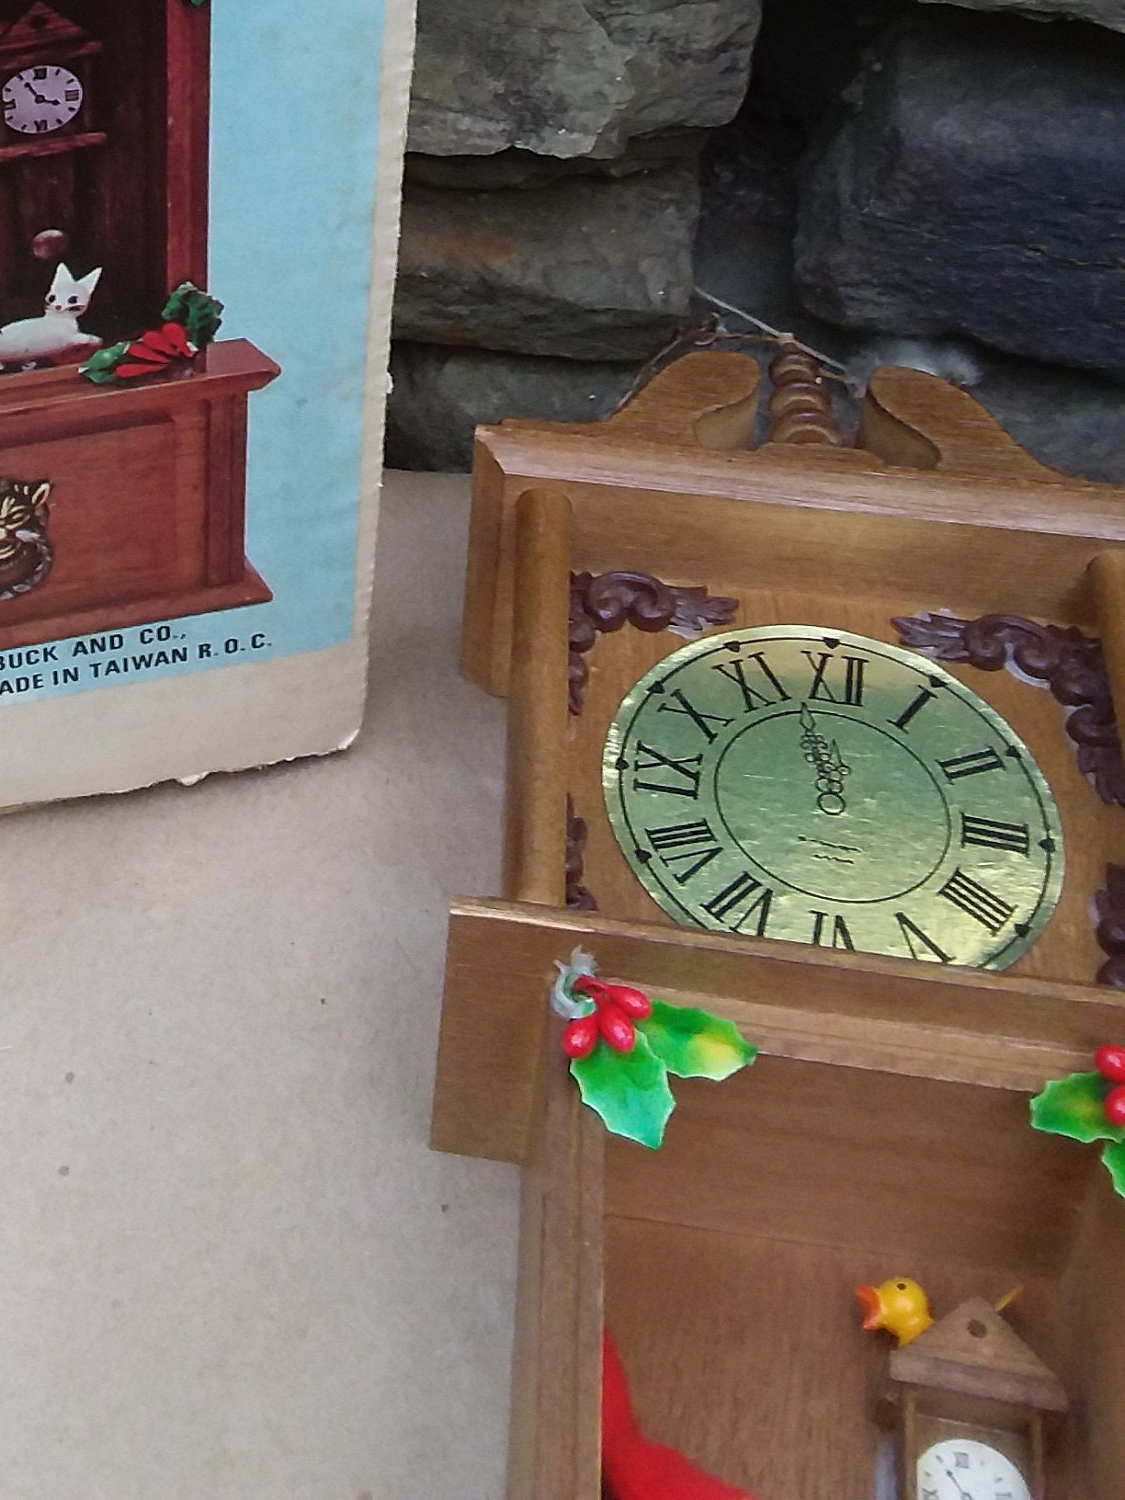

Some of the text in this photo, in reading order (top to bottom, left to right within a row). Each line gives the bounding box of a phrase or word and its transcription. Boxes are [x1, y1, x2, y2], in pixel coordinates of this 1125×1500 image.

[52, 666, 80, 687] IN
[89, 646, 189, 679] TAIWAN
[71, 633, 125, 658] AND
[800, 650, 869, 707] XII
[961, 810, 1030, 859] III
